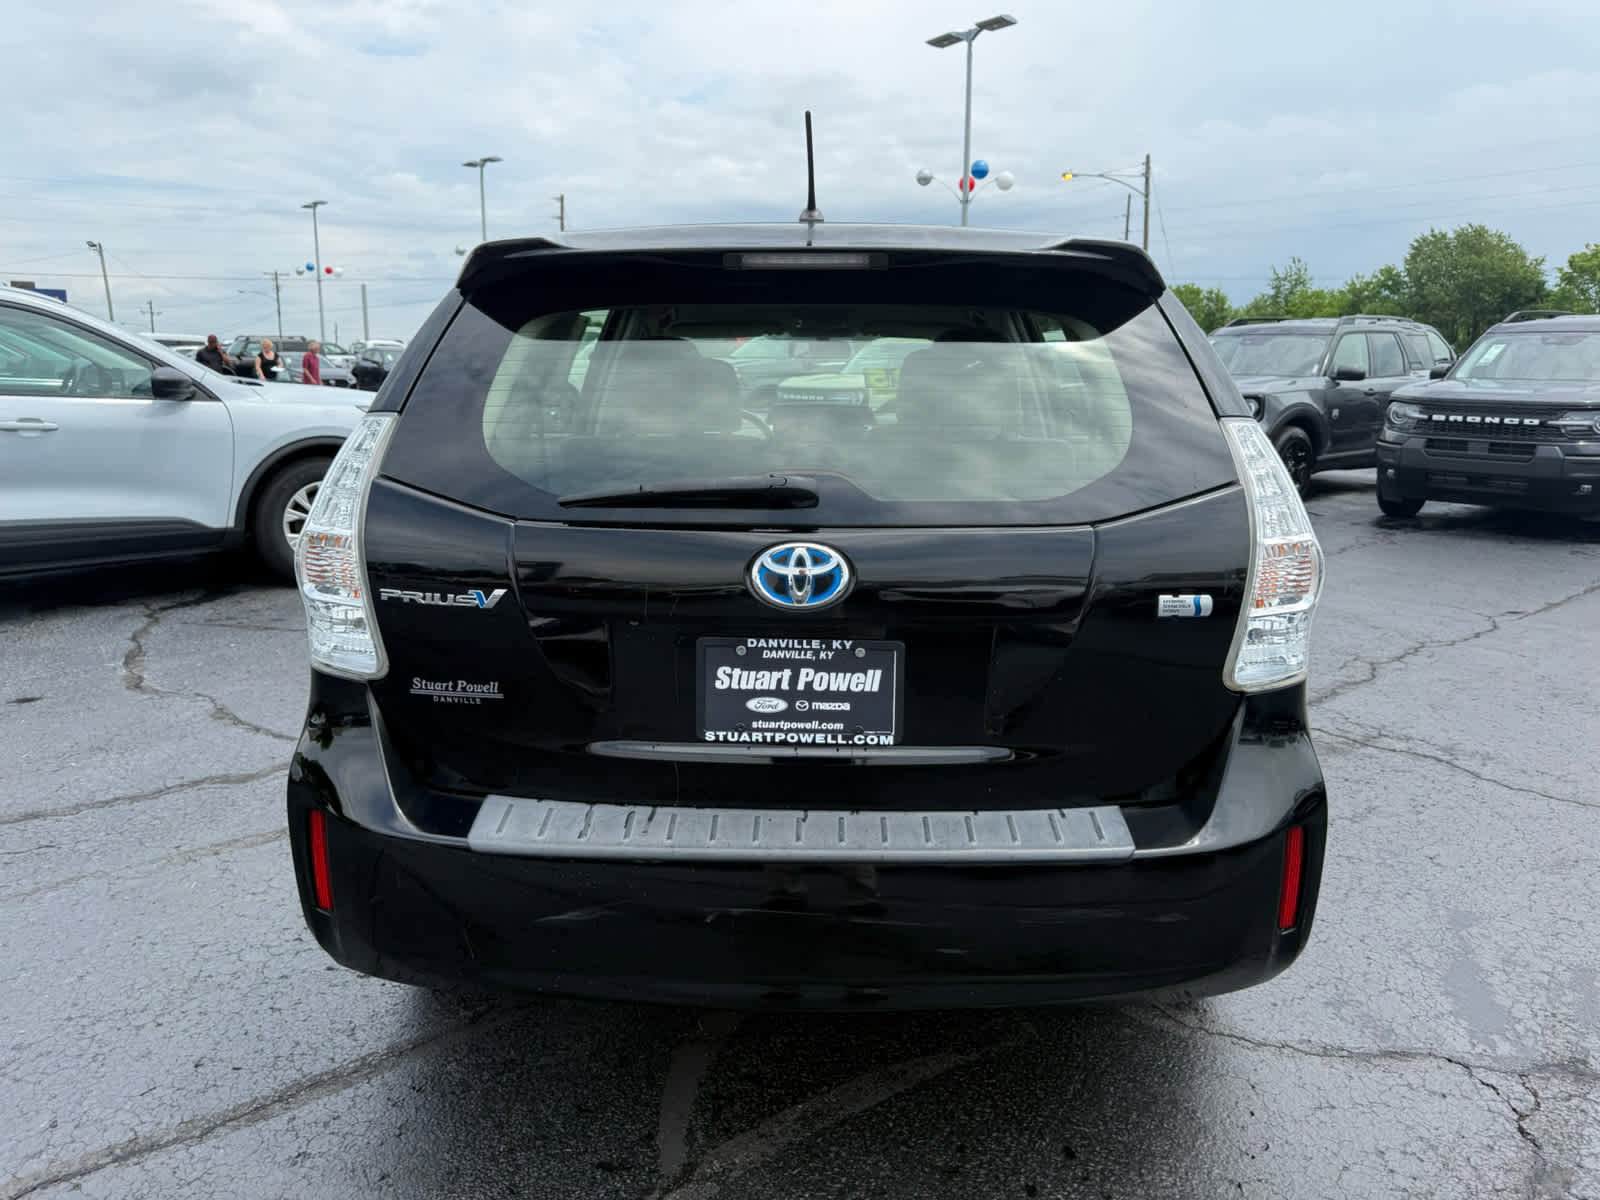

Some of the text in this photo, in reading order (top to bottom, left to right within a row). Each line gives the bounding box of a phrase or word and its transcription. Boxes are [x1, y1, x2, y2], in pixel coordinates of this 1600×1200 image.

[1432, 414, 1540, 425] BRONCO
[747, 638, 853, 649] DANVILLE, KY
[762, 650, 835, 660] DANVILLE, KY
[715, 666, 882, 692] Stuart Powell
[412, 677, 499, 693] Stuart Powell
[433, 696, 481, 704] DANVILLE
[752, 720, 844, 731] stuartpowell.com
[704, 731, 894, 745] STUARTPOWELL.COM
